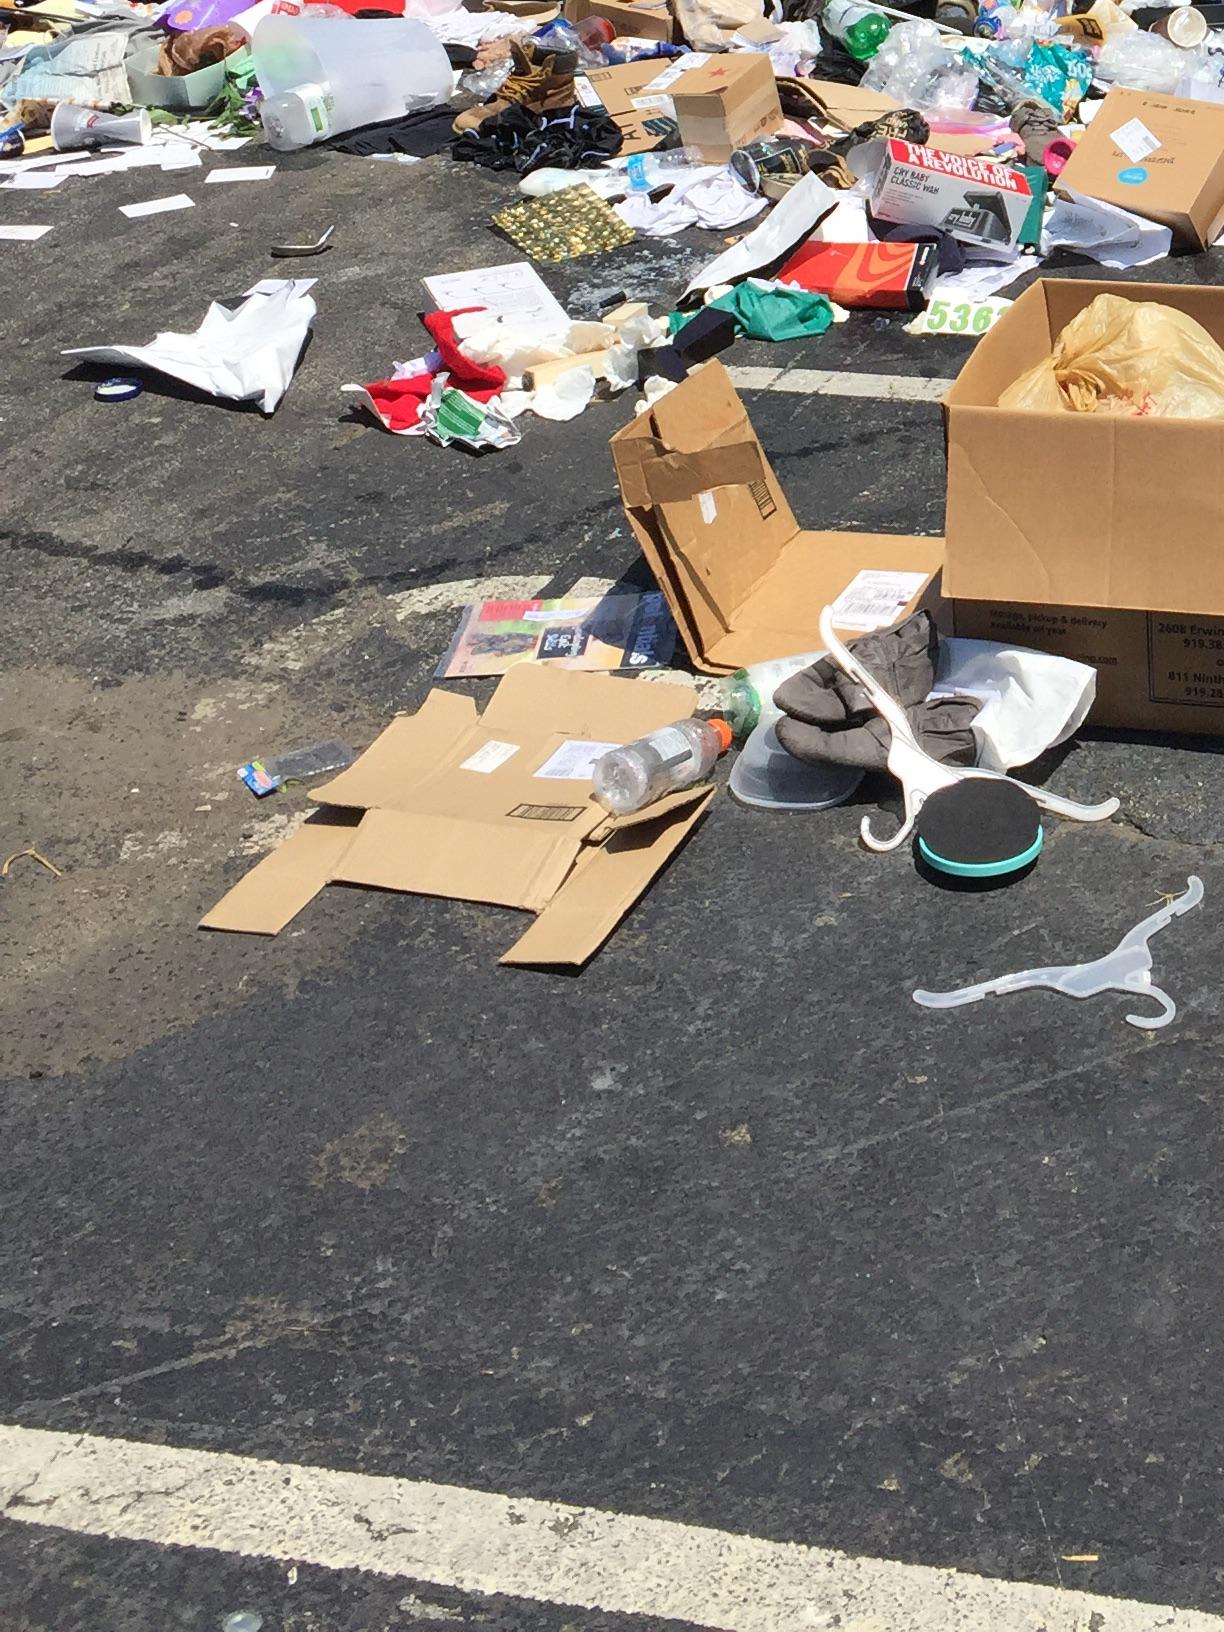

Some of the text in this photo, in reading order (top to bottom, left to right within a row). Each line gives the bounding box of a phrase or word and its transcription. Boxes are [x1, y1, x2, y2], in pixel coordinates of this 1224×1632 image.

[907, 143, 1016, 180] THE VOICE OF
[894, 166, 931, 182] CRY BABY
[907, 155, 1018, 190] A REVOLUTION
[890, 177, 940, 195] CLASSIC WAH
[1028, 613, 1058, 624] pickup
[1060, 615, 1068, 624] &
[1070, 616, 1107, 629] delivery
[1159, 623, 1186, 634] 2608
[1190, 626, 1224, 636] Erwin
[1168, 671, 1188, 682] 811
